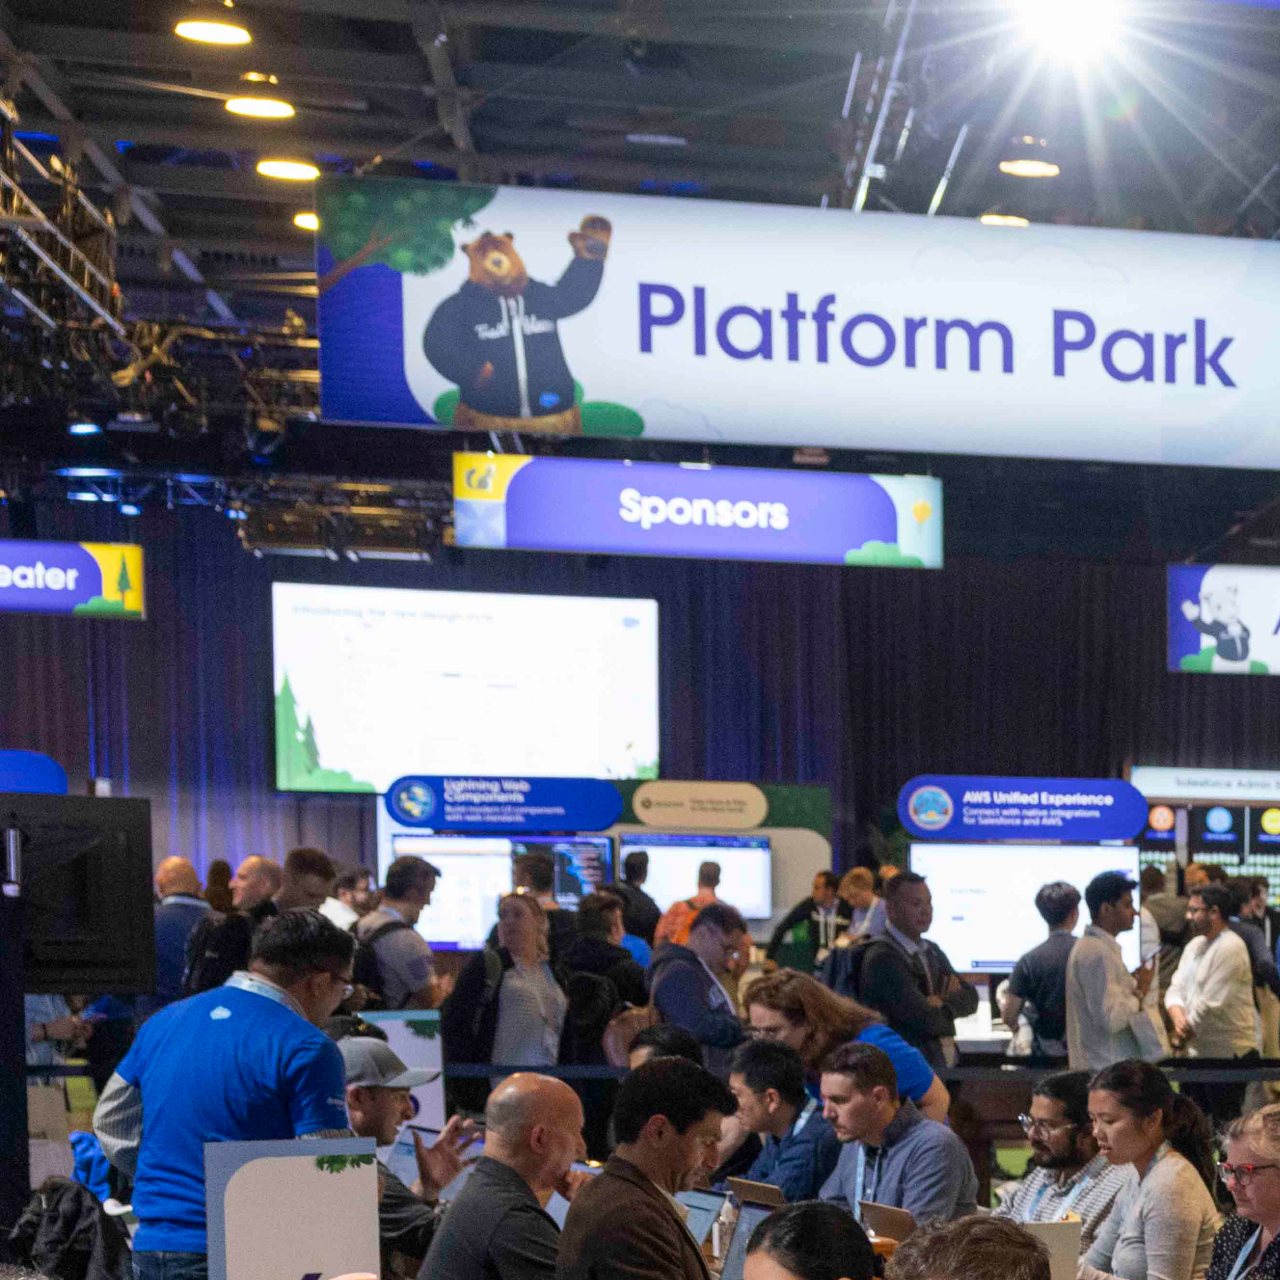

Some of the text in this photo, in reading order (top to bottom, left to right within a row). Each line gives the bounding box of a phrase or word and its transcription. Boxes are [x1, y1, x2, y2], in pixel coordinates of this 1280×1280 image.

[638, 282, 1238, 389] Platform Park
[618, 487, 790, 531] Sponsors
[444, 777, 532, 793] Lightning Web
[444, 792, 526, 804] Components
[962, 790, 1115, 807] AWS Unified Experience
[978, 816, 1022, 826] Salesforce
